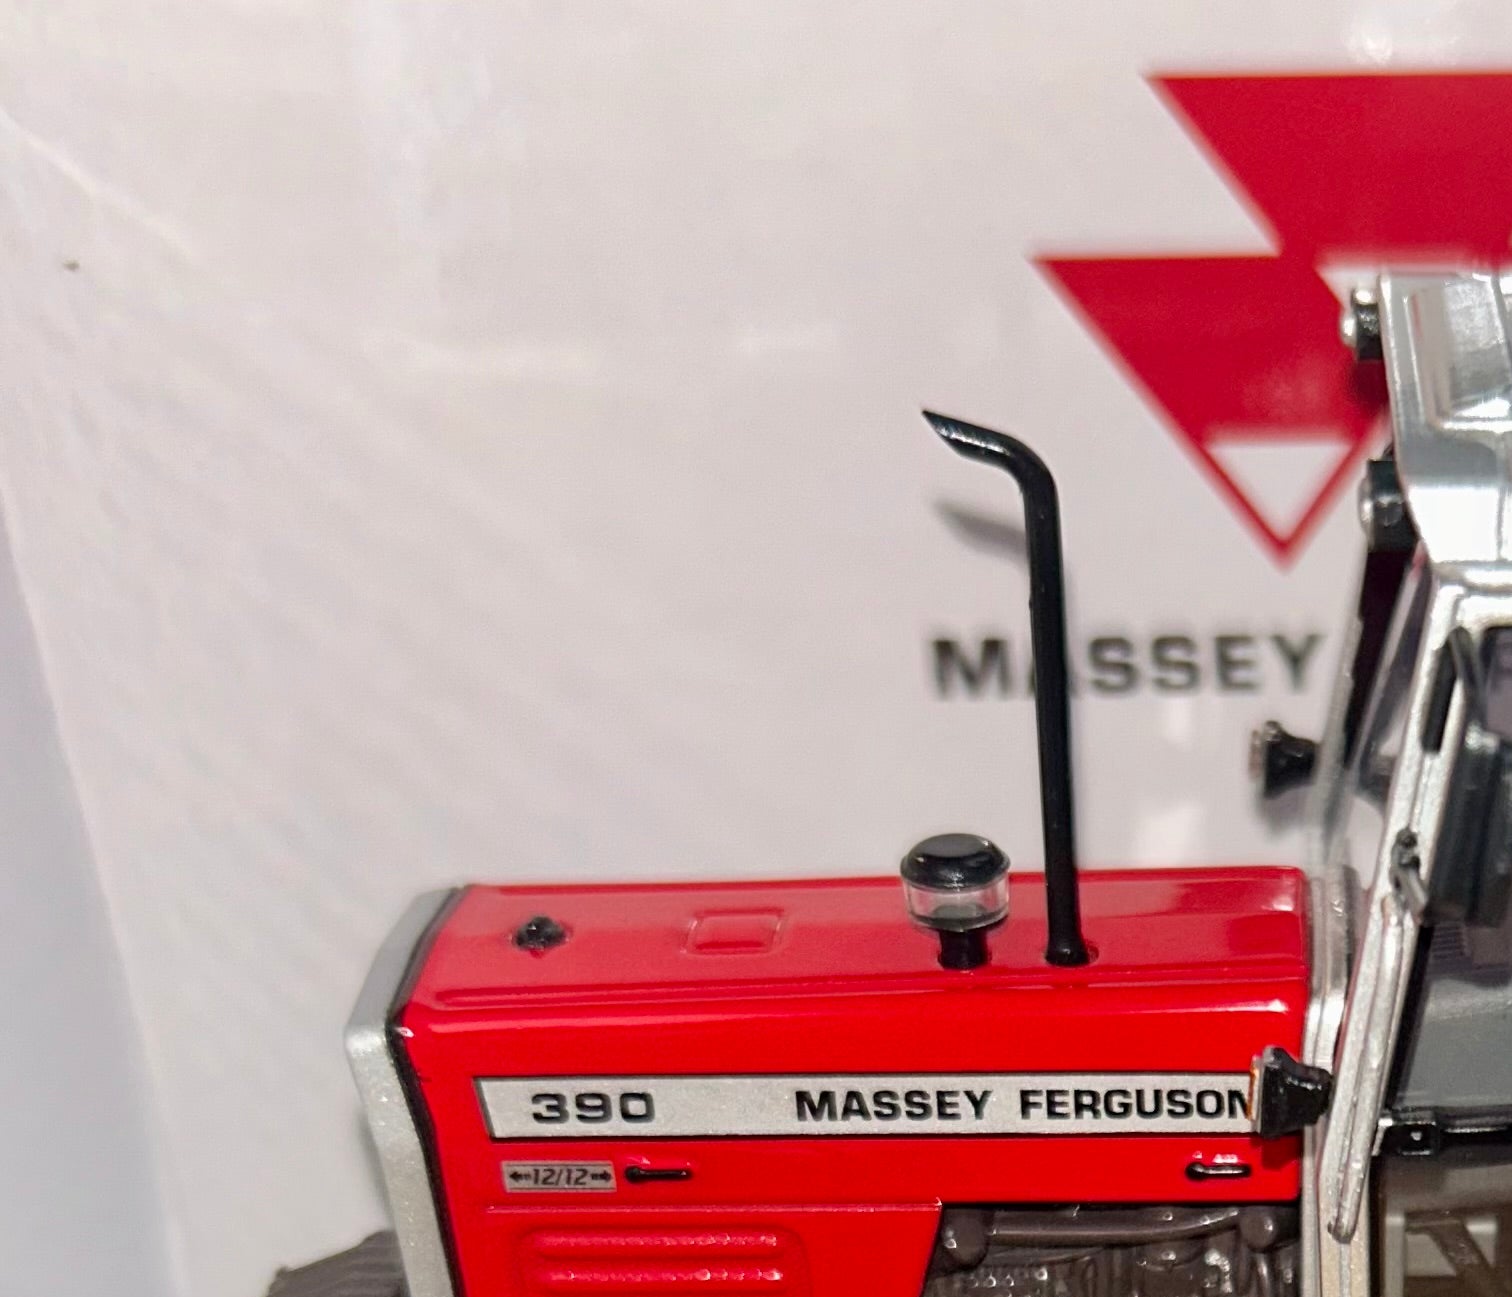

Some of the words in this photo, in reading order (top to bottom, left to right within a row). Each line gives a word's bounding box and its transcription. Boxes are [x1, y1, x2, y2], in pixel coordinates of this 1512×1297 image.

[931, 634, 1323, 698] MSSEY
[531, 1092, 655, 1124] 390
[795, 1090, 993, 1121] MASSEY
[1020, 1089, 1252, 1119] FERGUSON
[533, 1167, 589, 1187] 12/12
